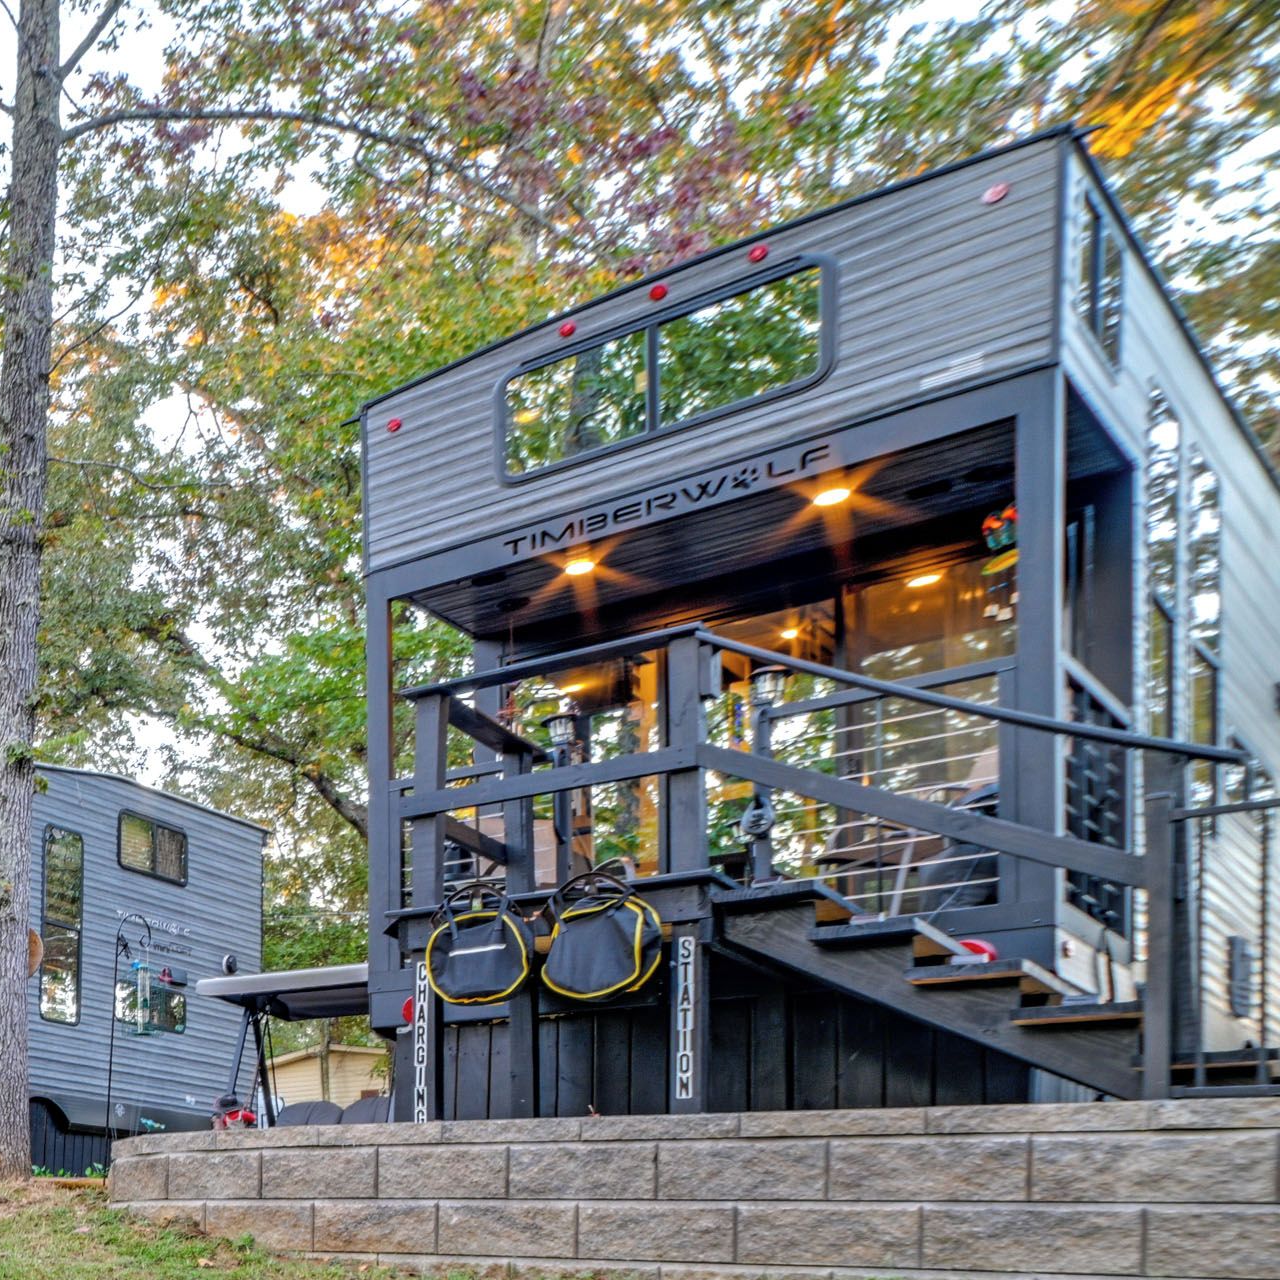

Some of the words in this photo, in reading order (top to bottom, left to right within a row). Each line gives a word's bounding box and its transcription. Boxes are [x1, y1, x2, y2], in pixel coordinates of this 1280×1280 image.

[503, 444, 830, 556] TIMBERWOLF
[416, 963, 427, 1124] CHARGING
[678, 939, 693, 1098] STATION
